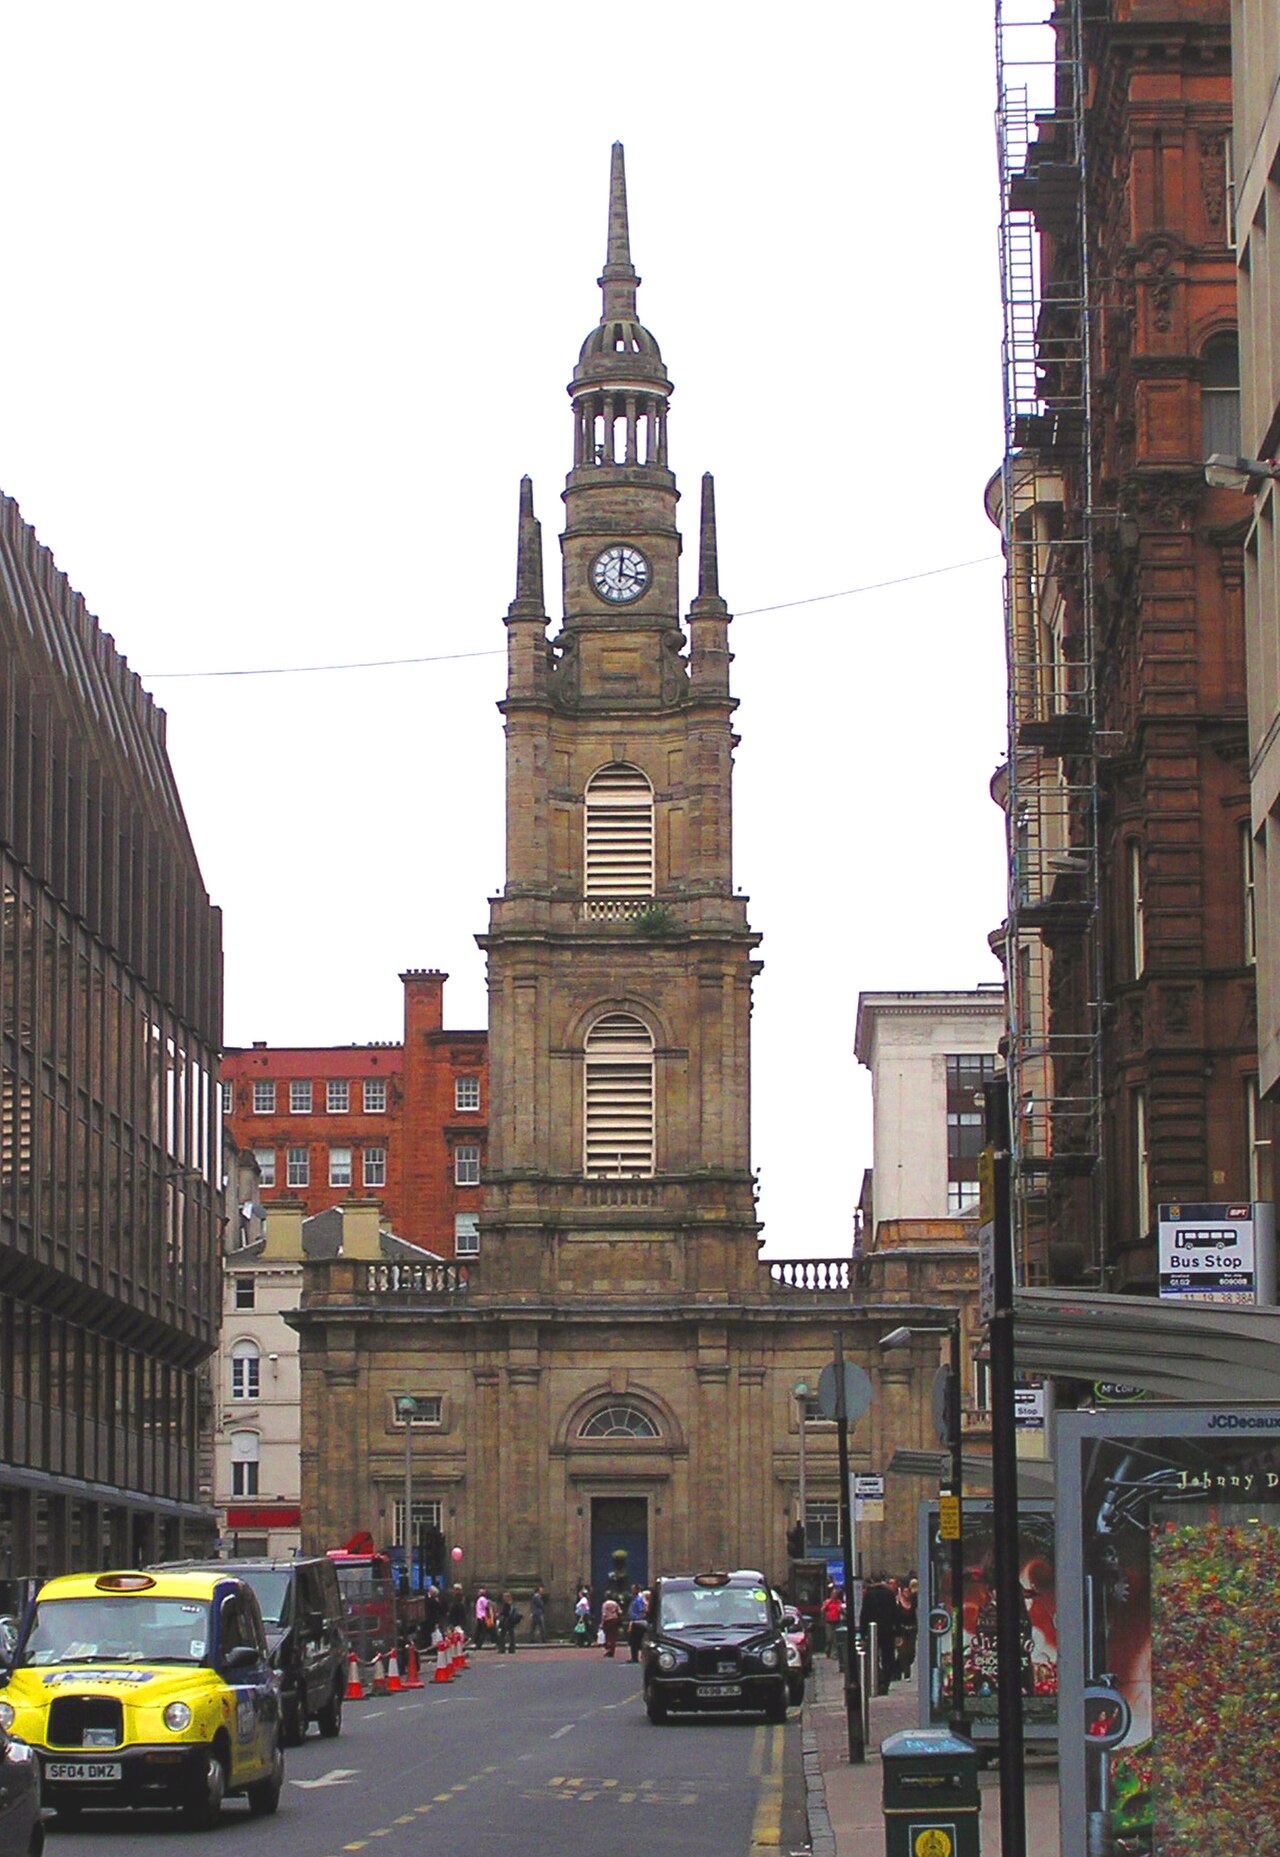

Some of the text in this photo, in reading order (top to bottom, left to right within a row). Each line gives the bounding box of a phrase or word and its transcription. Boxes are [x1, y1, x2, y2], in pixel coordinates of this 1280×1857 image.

[1170, 1254, 1242, 1269] Bus Stop
[1207, 1414, 1280, 1429] JCDecaux
[1176, 1470, 1255, 1490] Johnny
[50, 1765, 114, 1778] SF04 DMZ
